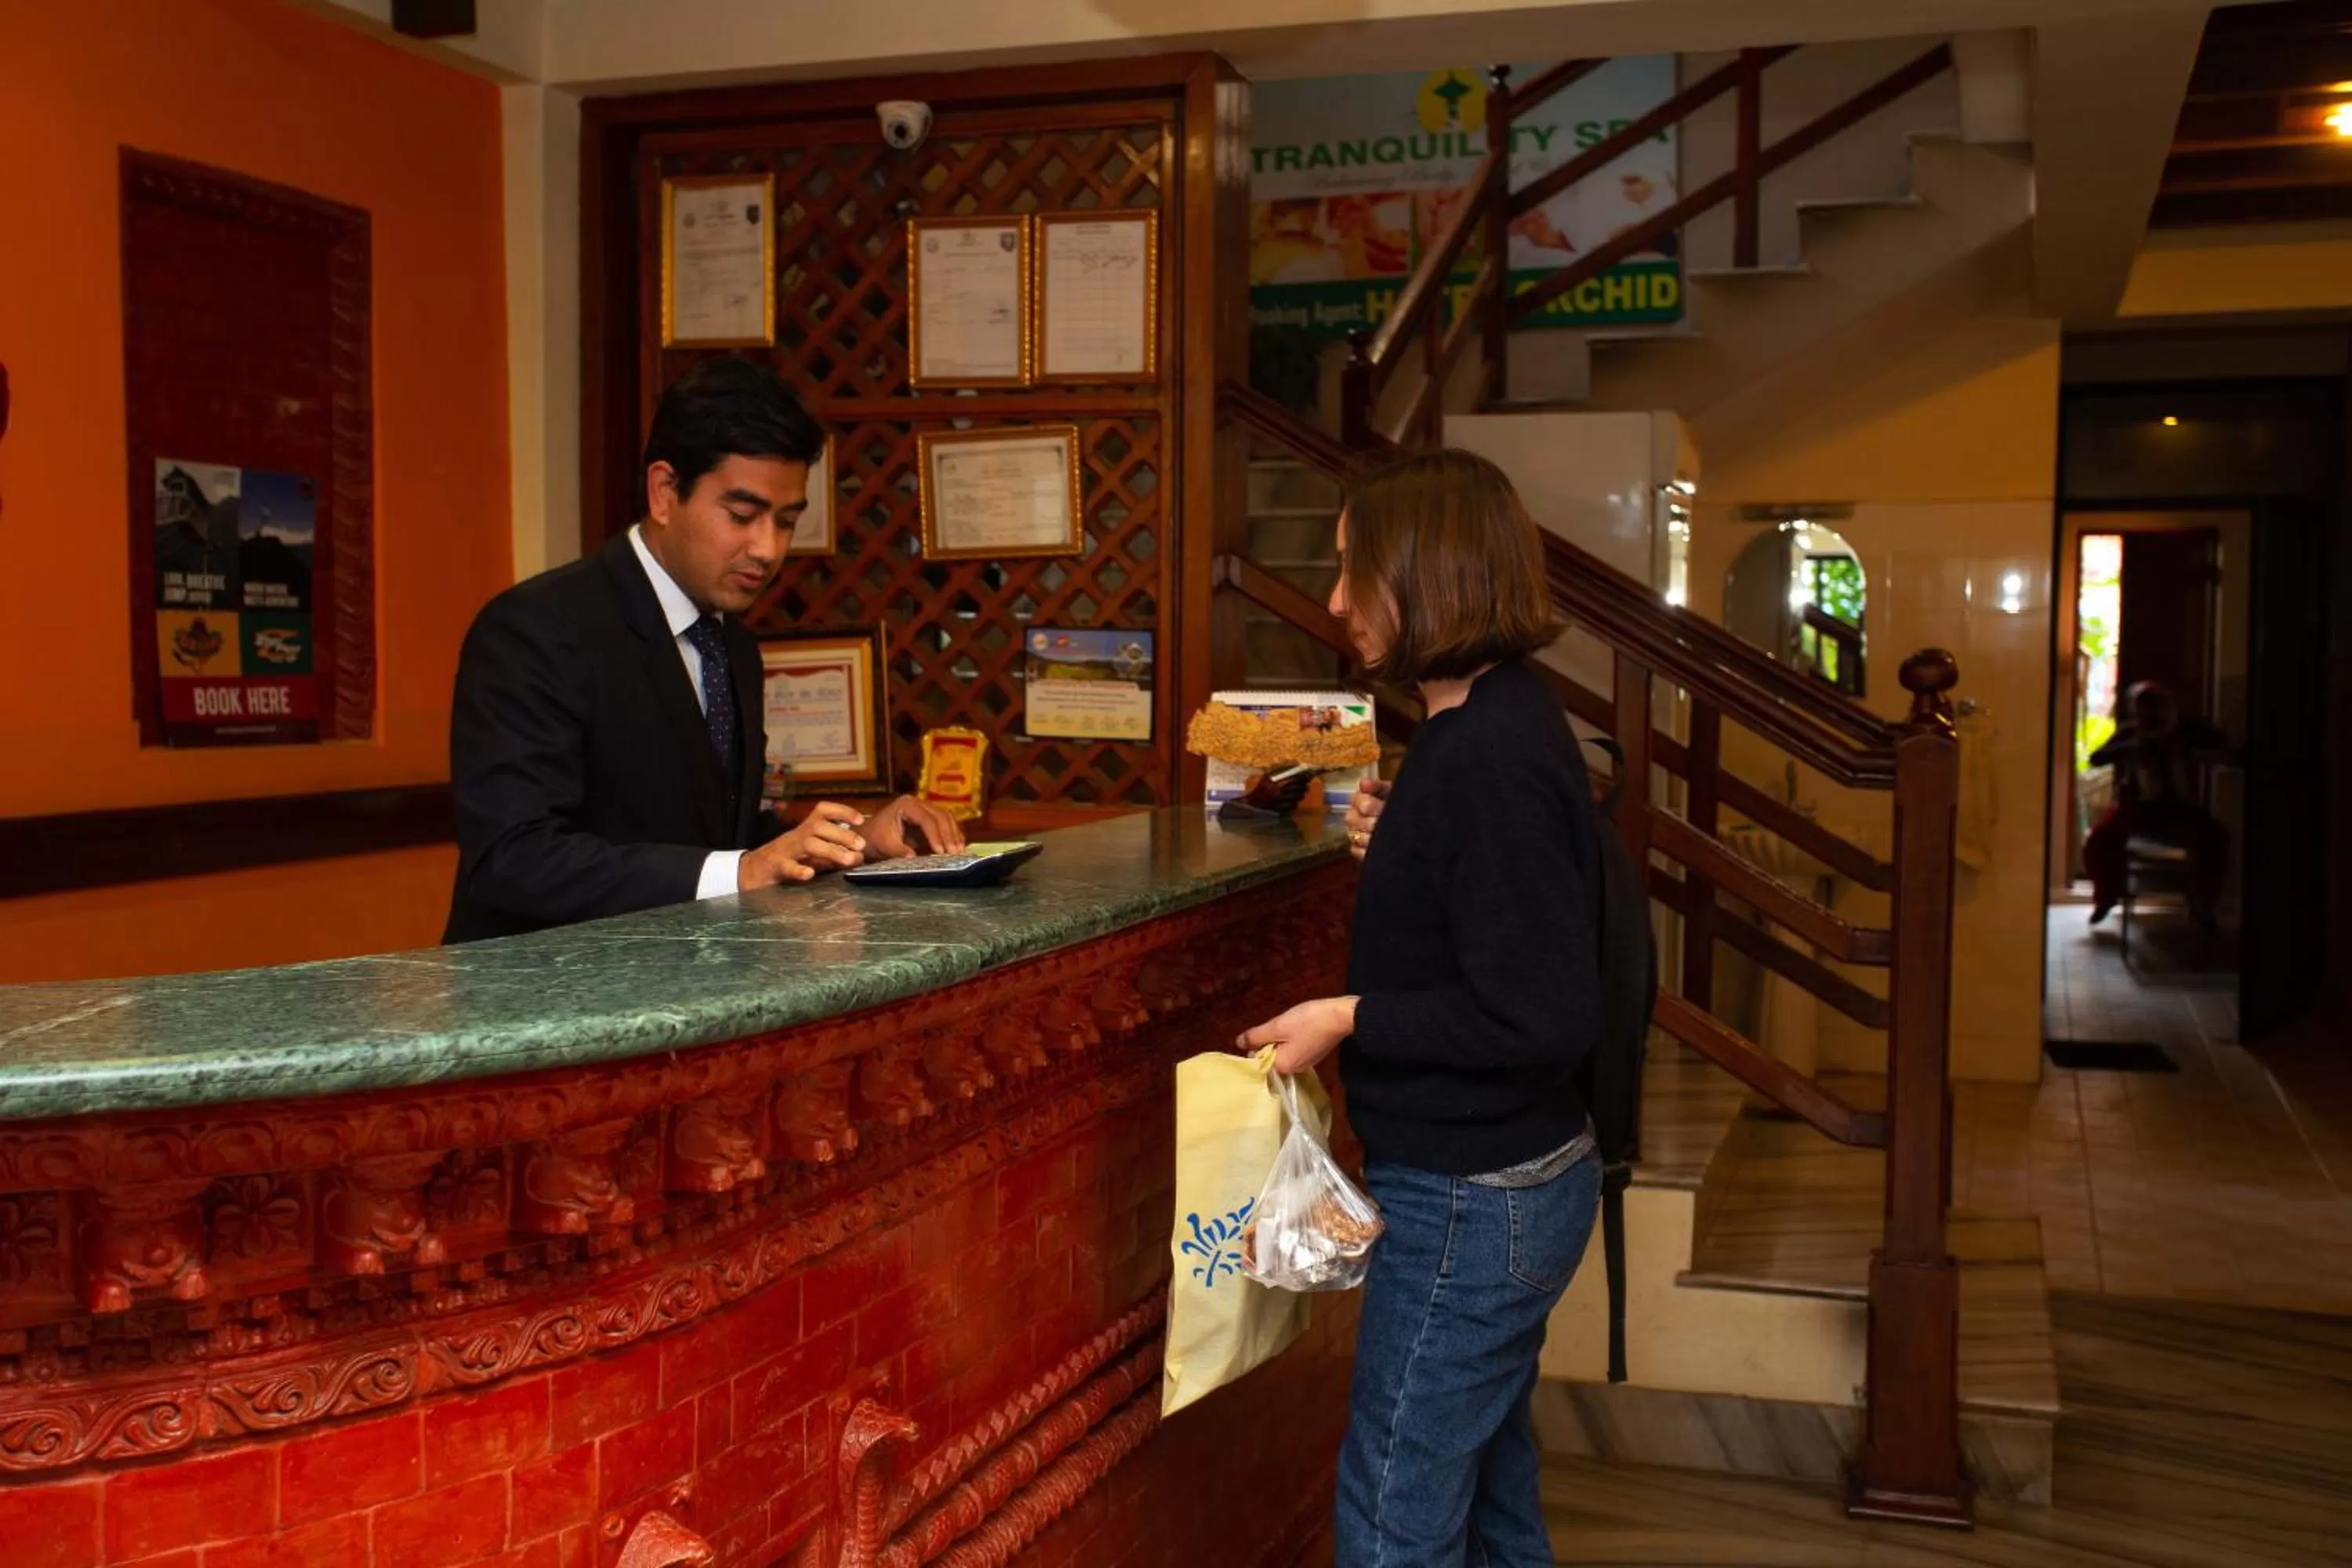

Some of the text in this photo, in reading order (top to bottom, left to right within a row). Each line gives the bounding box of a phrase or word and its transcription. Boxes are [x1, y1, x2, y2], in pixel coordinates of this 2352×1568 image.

[1250, 125, 1557, 173] TRANQUILTY
[193, 685, 292, 716] BOOK HERE
